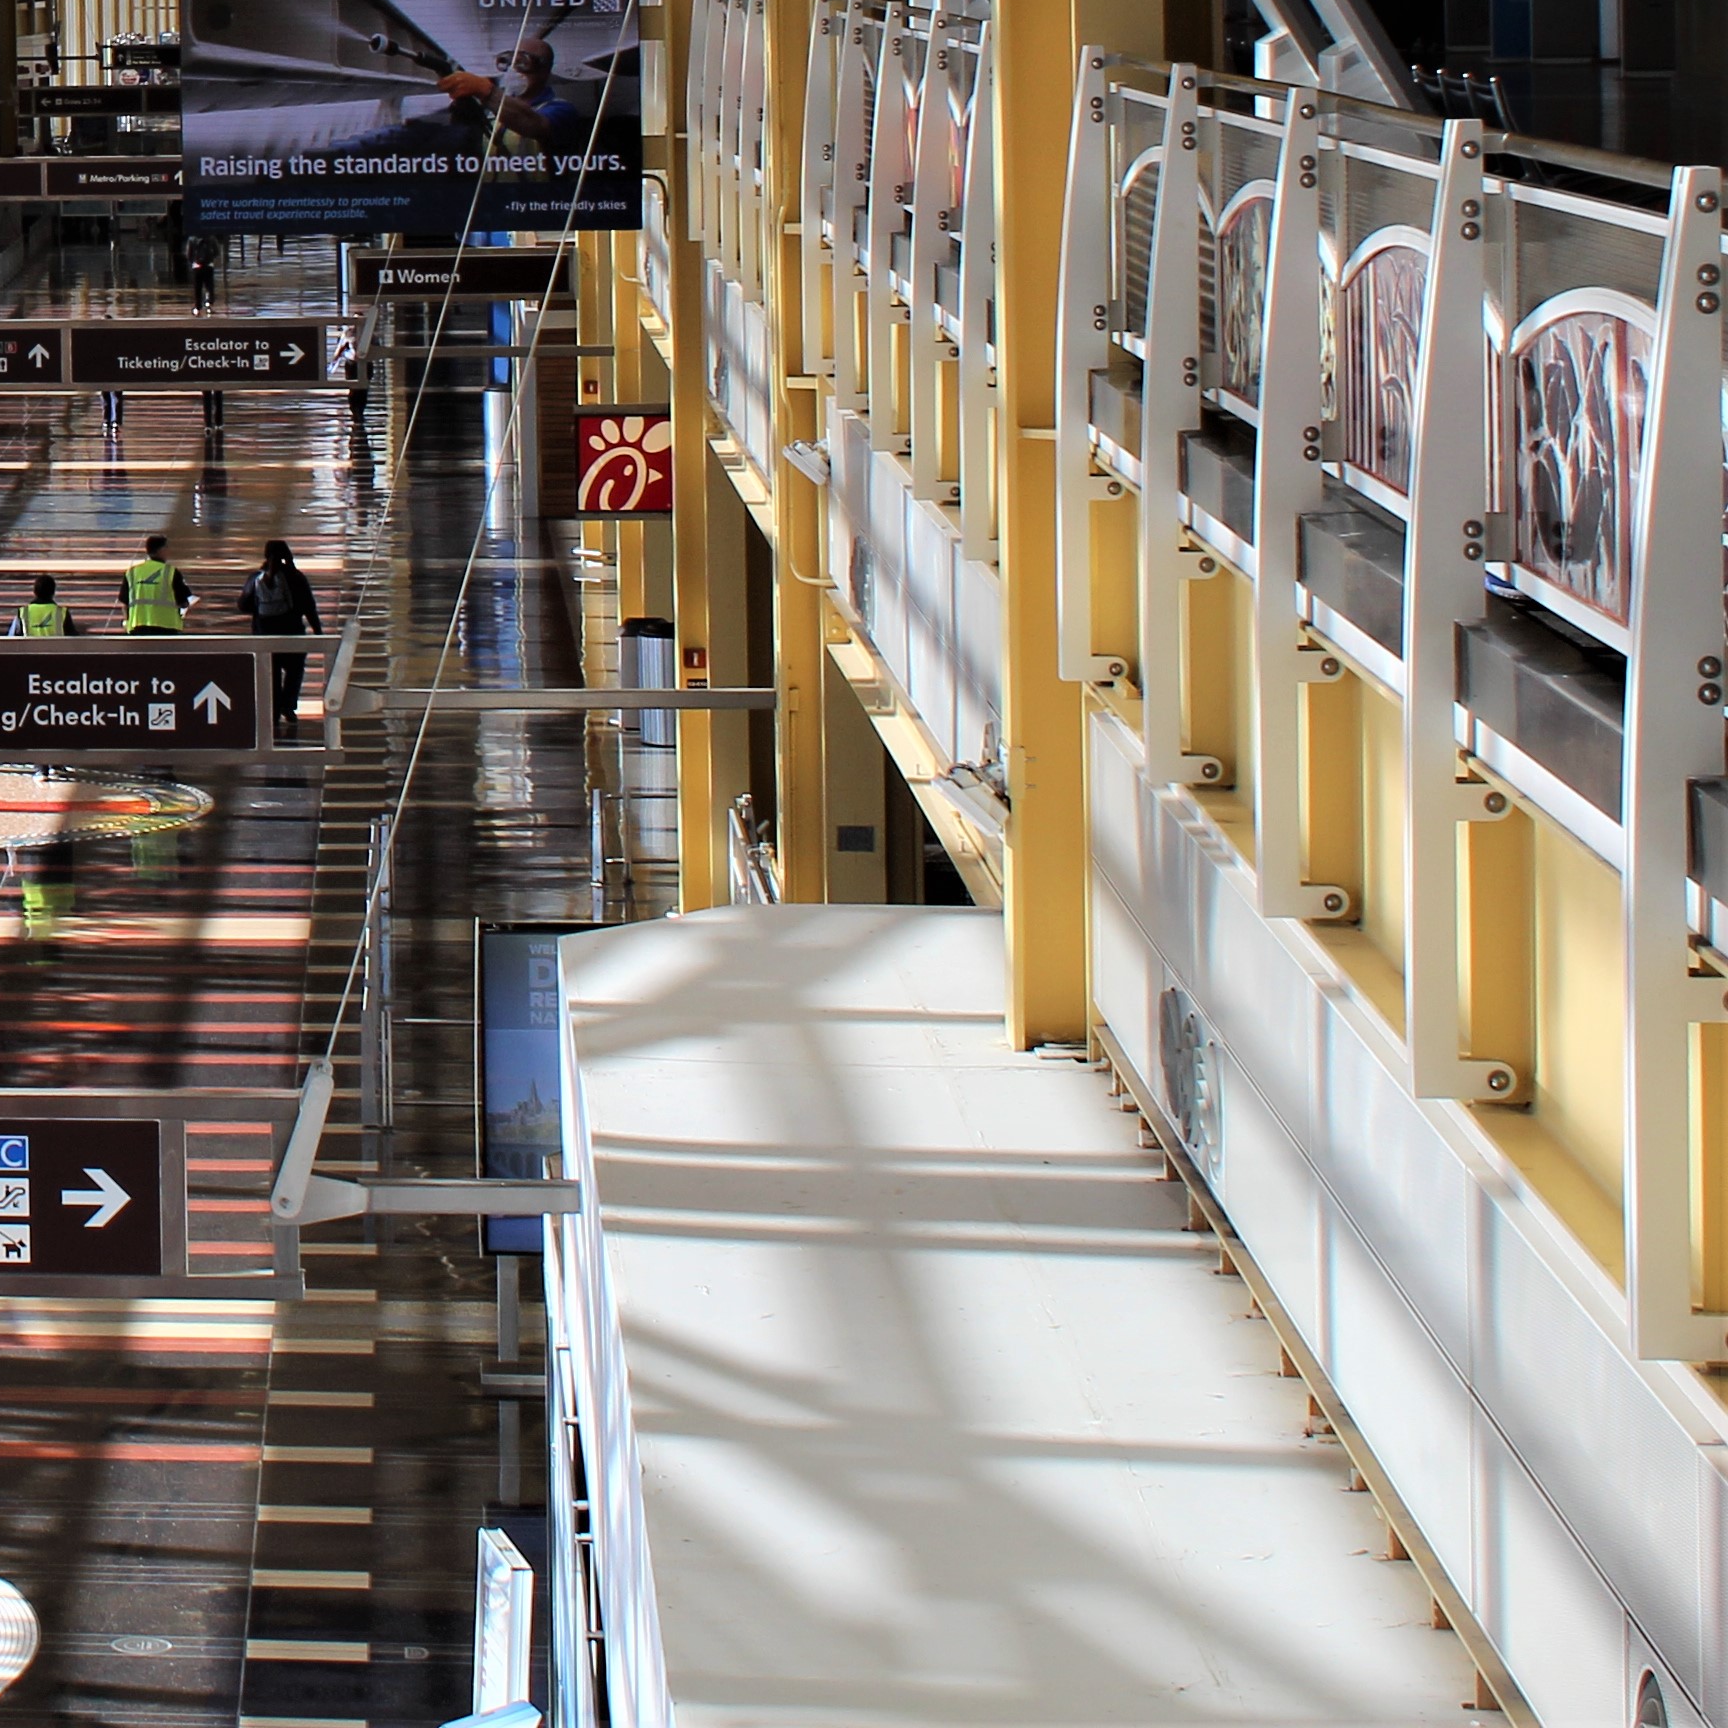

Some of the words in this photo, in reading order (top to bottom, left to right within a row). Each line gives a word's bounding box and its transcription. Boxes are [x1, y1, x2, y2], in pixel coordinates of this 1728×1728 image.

[200, 157, 282, 178] Raising
[288, 156, 327, 174] the
[333, 154, 448, 174] standards
[455, 154, 479, 172] to
[486, 153, 546, 172] meet
[554, 154, 627, 175] yours.
[90, 174, 150, 185] Metro/Parking
[200, 198, 228, 208] We're
[232, 198, 275, 208] working
[338, 196, 348, 206] to
[351, 196, 391, 208] provide
[393, 196, 410, 205] the
[530, 201, 547, 210] the
[551, 201, 594, 211] friendly
[598, 200, 627, 210] skies
[200, 210, 230, 220] safest
[234, 209, 264, 219] travel
[266, 210, 321, 221] experience
[323, 209, 368, 221] possible.
[397, 270, 461, 283] Women
[186, 338, 248, 350] Escalator
[256, 341, 269, 349] to
[118, 356, 249, 371] Ticketing/Check-In
[29, 673, 139, 694] Escalator
[152, 678, 175, 694] to
[1, 1140, 21, 1165] C
